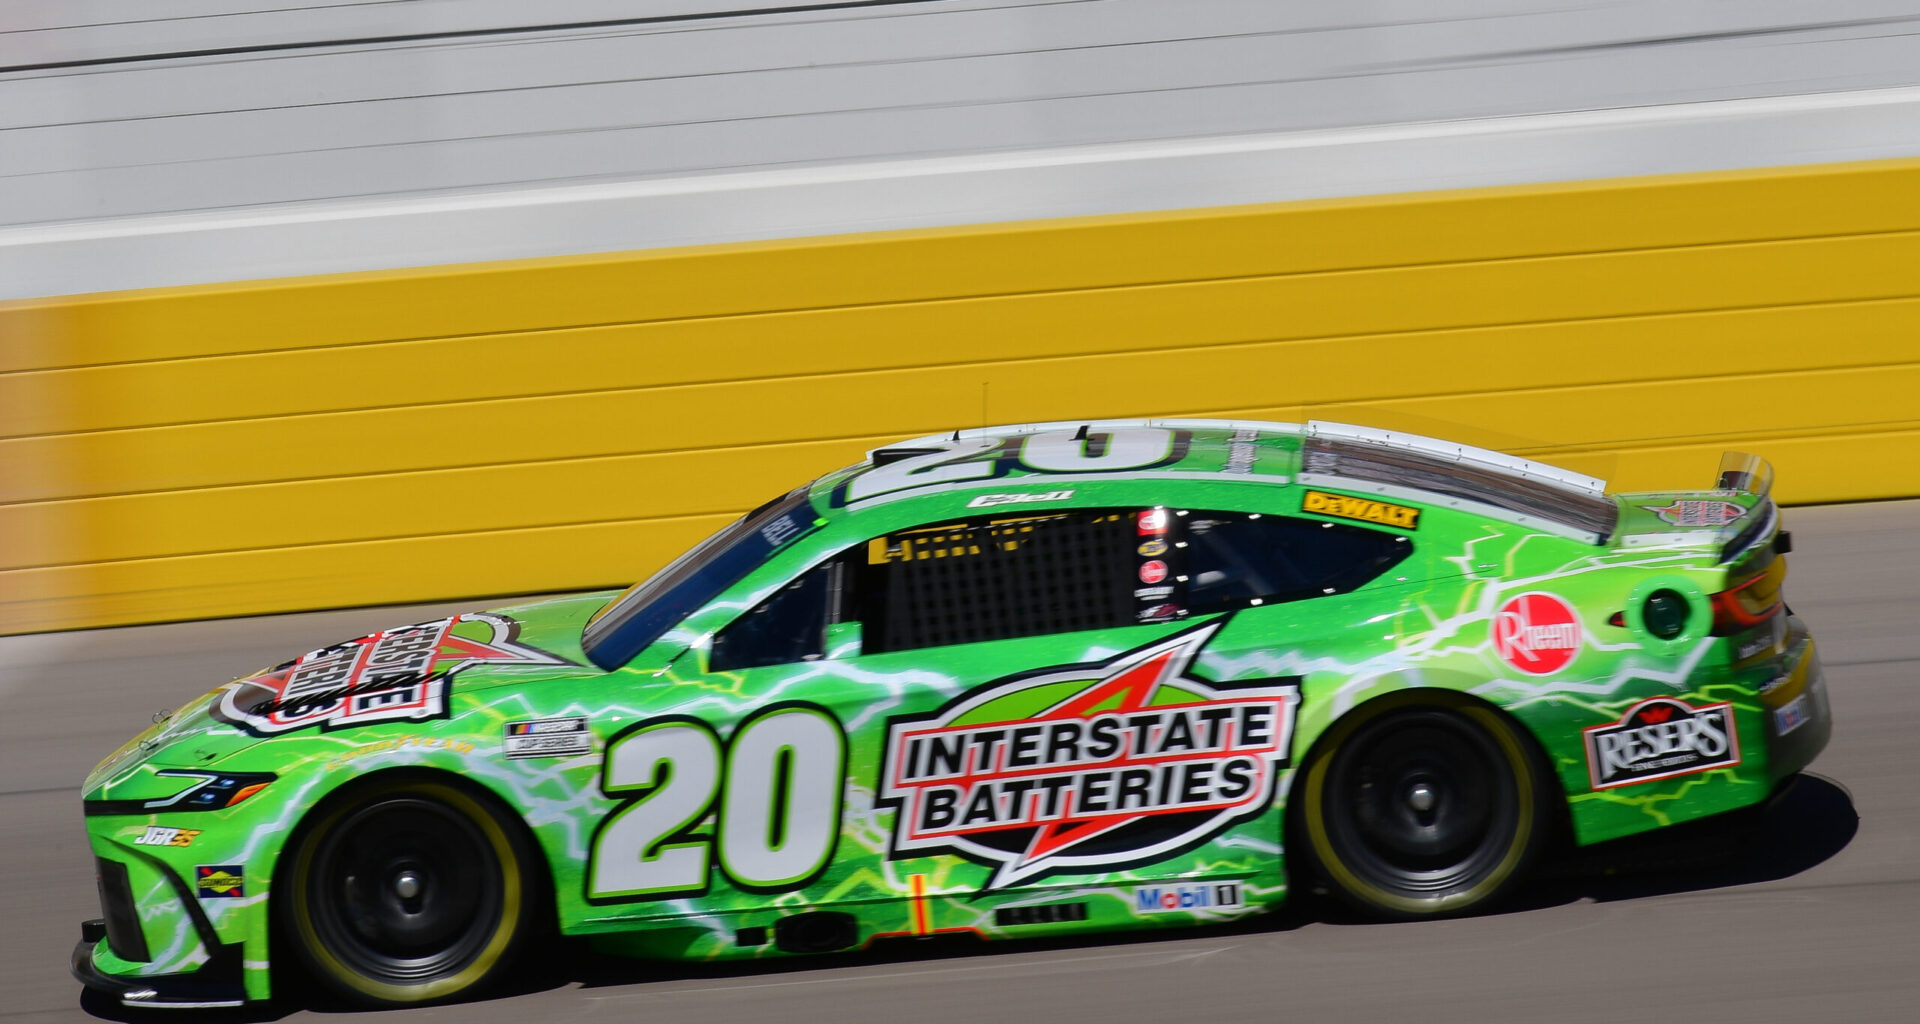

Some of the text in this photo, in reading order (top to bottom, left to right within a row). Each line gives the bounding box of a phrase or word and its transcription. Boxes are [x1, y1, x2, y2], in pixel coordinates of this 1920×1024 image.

[838, 429, 1184, 505] 20
[761, 514, 800, 547] BELL
[1494, 596, 1580, 661] Rheem
[905, 704, 1273, 779] INTERSTATE
[1596, 713, 1728, 779] RESER'S
[586, 703, 846, 902] 20
[920, 759, 1253, 830] BATTERIES
[1136, 885, 1236, 911] Mobil 1
